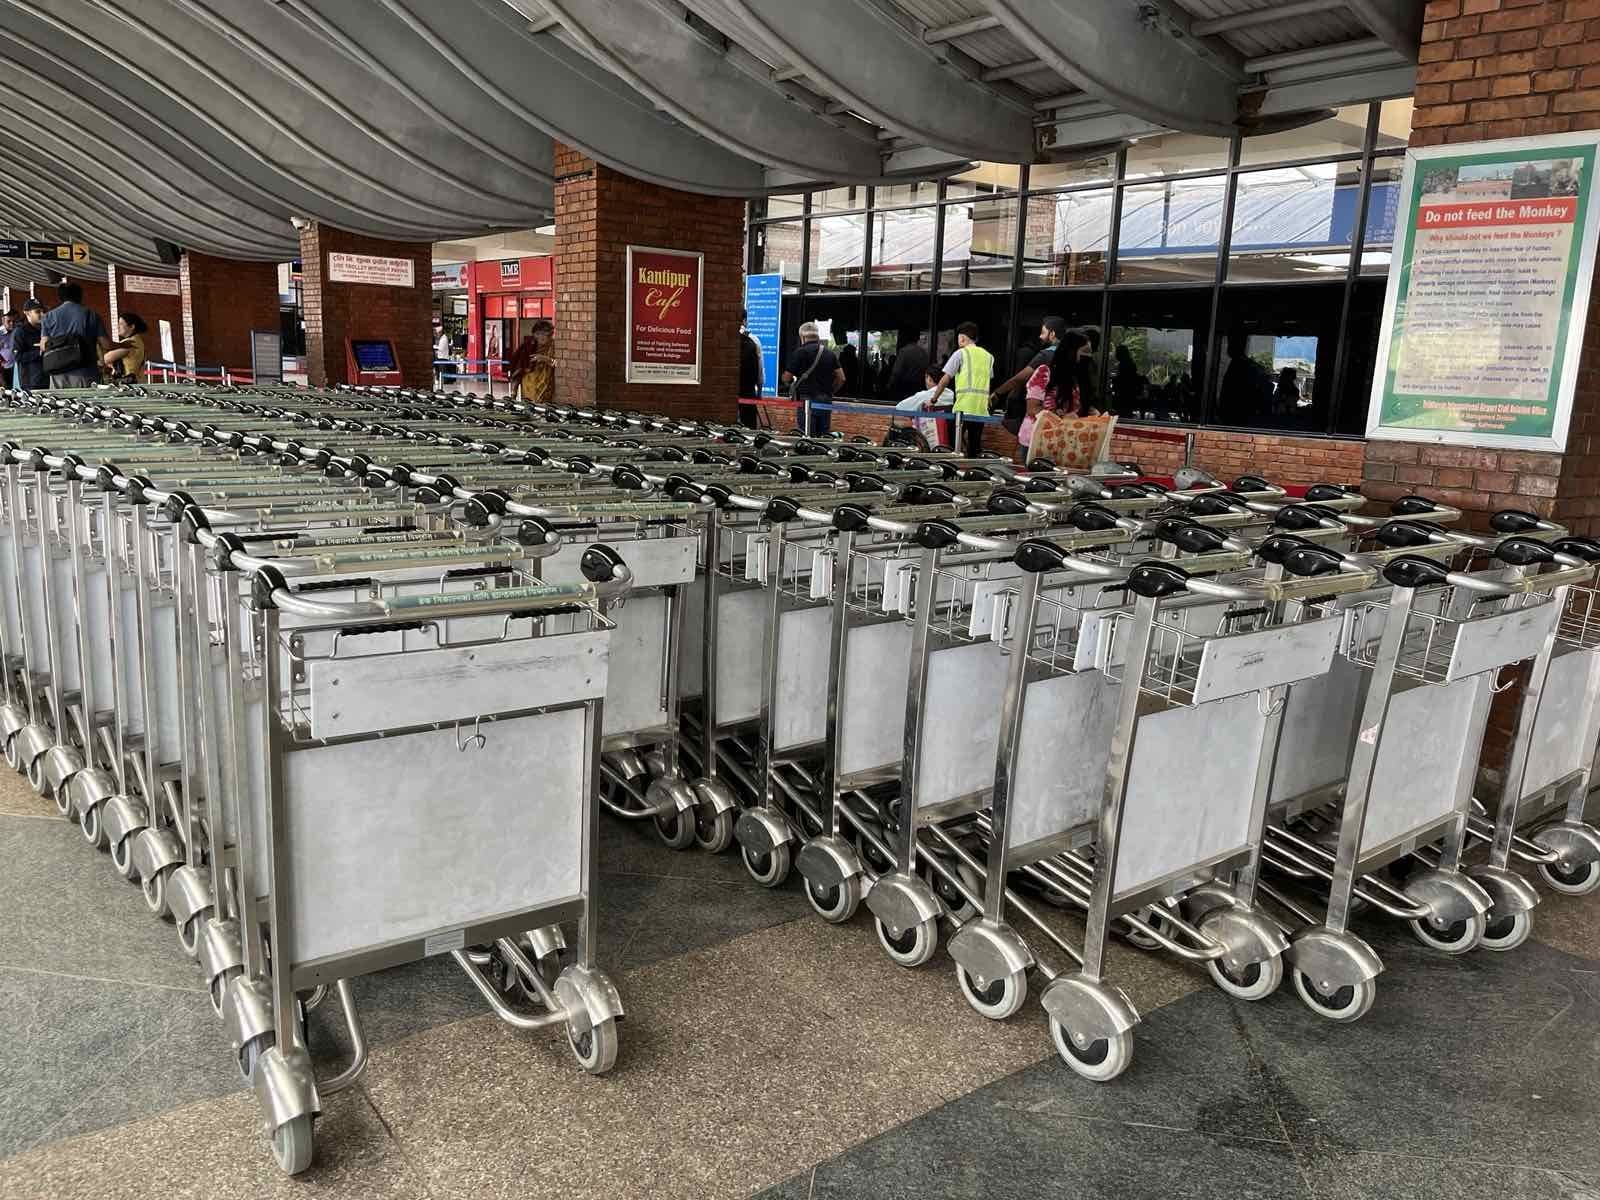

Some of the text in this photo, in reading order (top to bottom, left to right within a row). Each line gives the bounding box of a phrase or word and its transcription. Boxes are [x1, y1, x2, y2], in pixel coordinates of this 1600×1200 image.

[1425, 205, 1568, 223] Do not feed the Monkey
[639, 267, 691, 288] Kantipur
[636, 324, 692, 336] For Delicious Food
